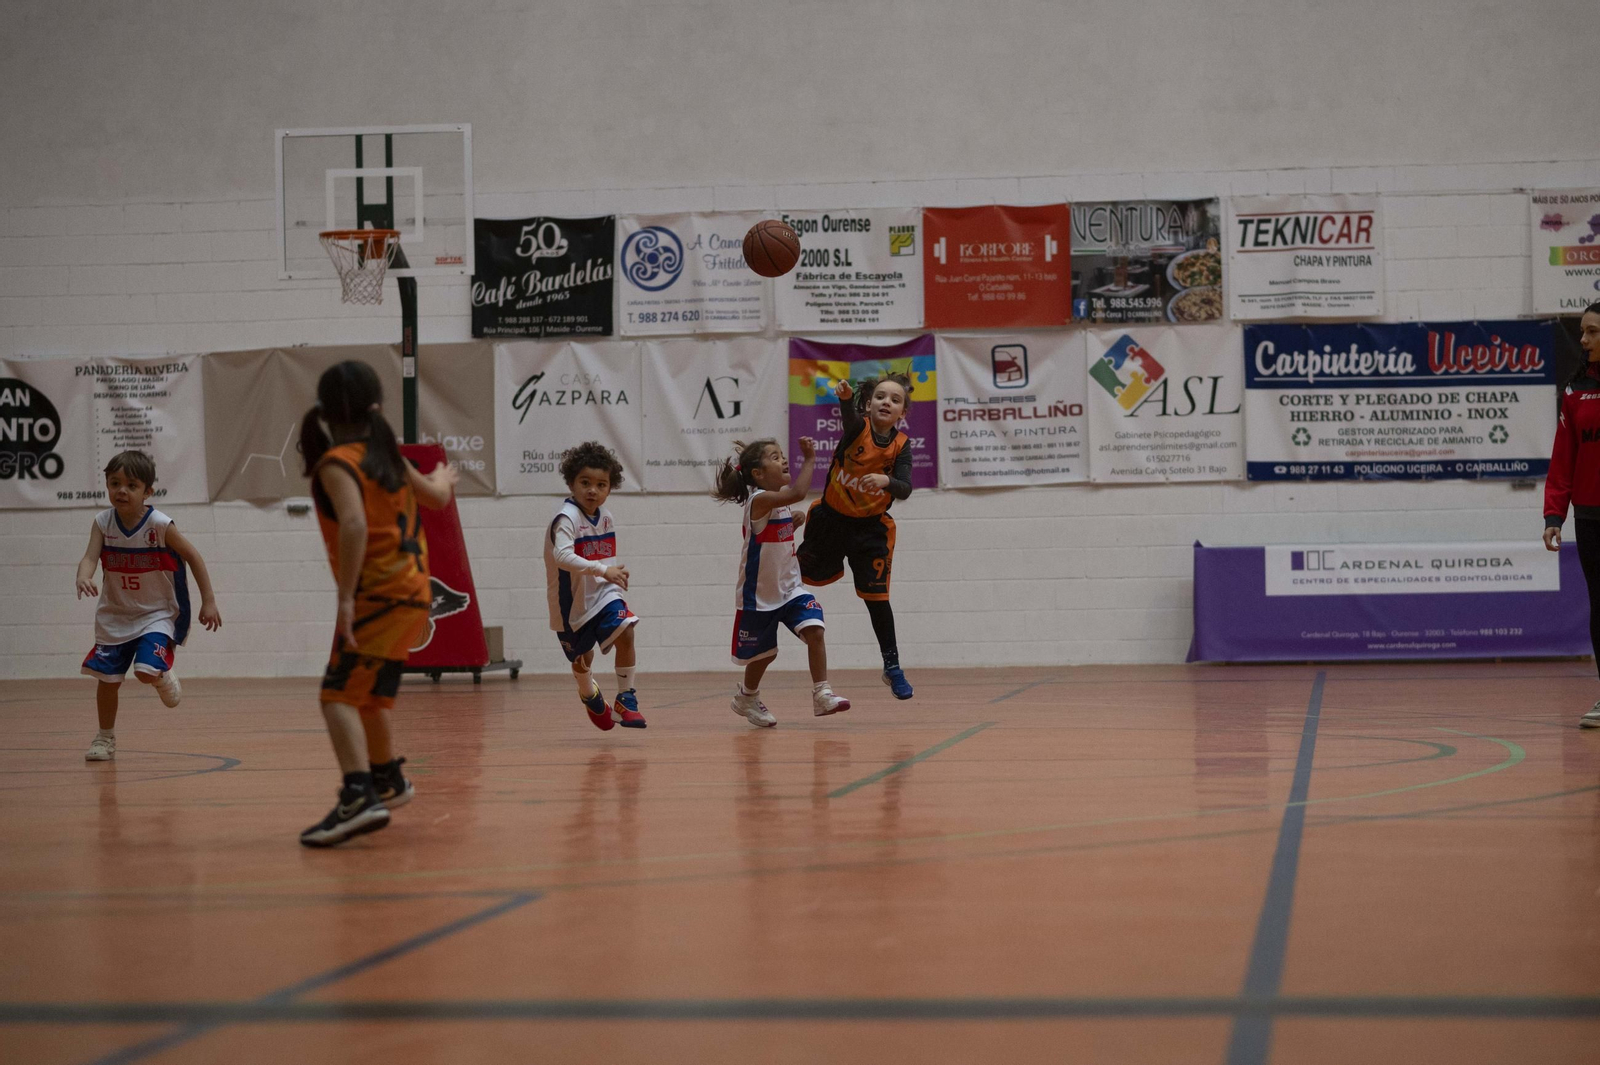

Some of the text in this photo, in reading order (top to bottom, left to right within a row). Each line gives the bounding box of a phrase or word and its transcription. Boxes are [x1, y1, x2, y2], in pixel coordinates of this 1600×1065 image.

[1549, 195, 1558, 204] DE
[1559, 195, 1569, 203] 50
[1570, 195, 1589, 203] ANOS
[782, 214, 871, 237] Esgon Ourense
[1072, 206, 1185, 243] VENTURA
[1237, 214, 1374, 248] TEKNICAR
[515, 218, 562, 257] 50
[686, 233, 744, 250] A Cana
[800, 248, 852, 267] 2000 S.L
[1293, 255, 1372, 267] CHAPA Y PINTURA
[1566, 249, 1600, 262] ORC
[471, 258, 614, 307] Café Bardelás
[796, 271, 903, 282] Fábrica de Escayola
[1091, 297, 1162, 308] Tel. 988.545.996
[628, 313, 636, 323] T.
[638, 312, 658, 323] 988
[660, 311, 679, 322] 274
[681, 310, 700, 321] 620
[1255, 331, 1545, 384] Carpintería Uceira
[75, 363, 189, 377] PANADERÍA RIVERA
[560, 373, 602, 386] CASA
[512, 371, 629, 425] GAZPARA
[693, 376, 744, 420] AG
[943, 395, 1037, 405] TALLERES
[1123, 376, 1241, 418] ASL
[1279, 391, 1520, 406] CORTE Y PLEGADO DE CHAPA
[943, 400, 1083, 422] CARBALLIÑO
[1289, 407, 1509, 423] HIERRO ALUMINIO INOX
[0, 419, 57, 443] NTO
[718, 426, 753, 434] GARRIGA
[949, 430, 997, 439] CHAPA
[1014, 426, 1078, 438] PINTURA
[1114, 429, 1221, 442] Gabinete Psicopedagógico
[1337, 426, 1464, 436] GESTOR AUTORIZADO PARA
[806, 437, 841, 451] ania
[1318, 436, 1484, 446] RETIRADA Y RECICLAJE DE AMIANTO
[523, 448, 544, 460] Rúa
[855, 445, 864, 457] 9
[520, 462, 555, 474] 32500
[1110, 465, 1227, 476] Avenida Calvo Sotelo 31 Bajo
[1289, 461, 1529, 474] 988 27 11 43 POLÍGONO UCEIRA O CARBALLIÑO
[57, 491, 106, 500] 988 288481
[872, 558, 885, 579] 9
[1431, 557, 1514, 571] QUIROGA
[120, 576, 140, 591] 15
[1336, 577, 1350, 585] DE
[1354, 576, 1441, 584] ESPECIALIDADES
[1444, 574, 1533, 582] ODONTOLÓGICAS
[1300, 630, 1331, 639] Cardenal
[1391, 630, 1420, 638] Ourense
[1425, 629, 1445, 637] 32003
[1479, 628, 1493, 636] 988
[1495, 628, 1508, 636] 103
[1509, 627, 1523, 636] 232
[1367, 641, 1457, 651] www.cardenalquiroga.com
